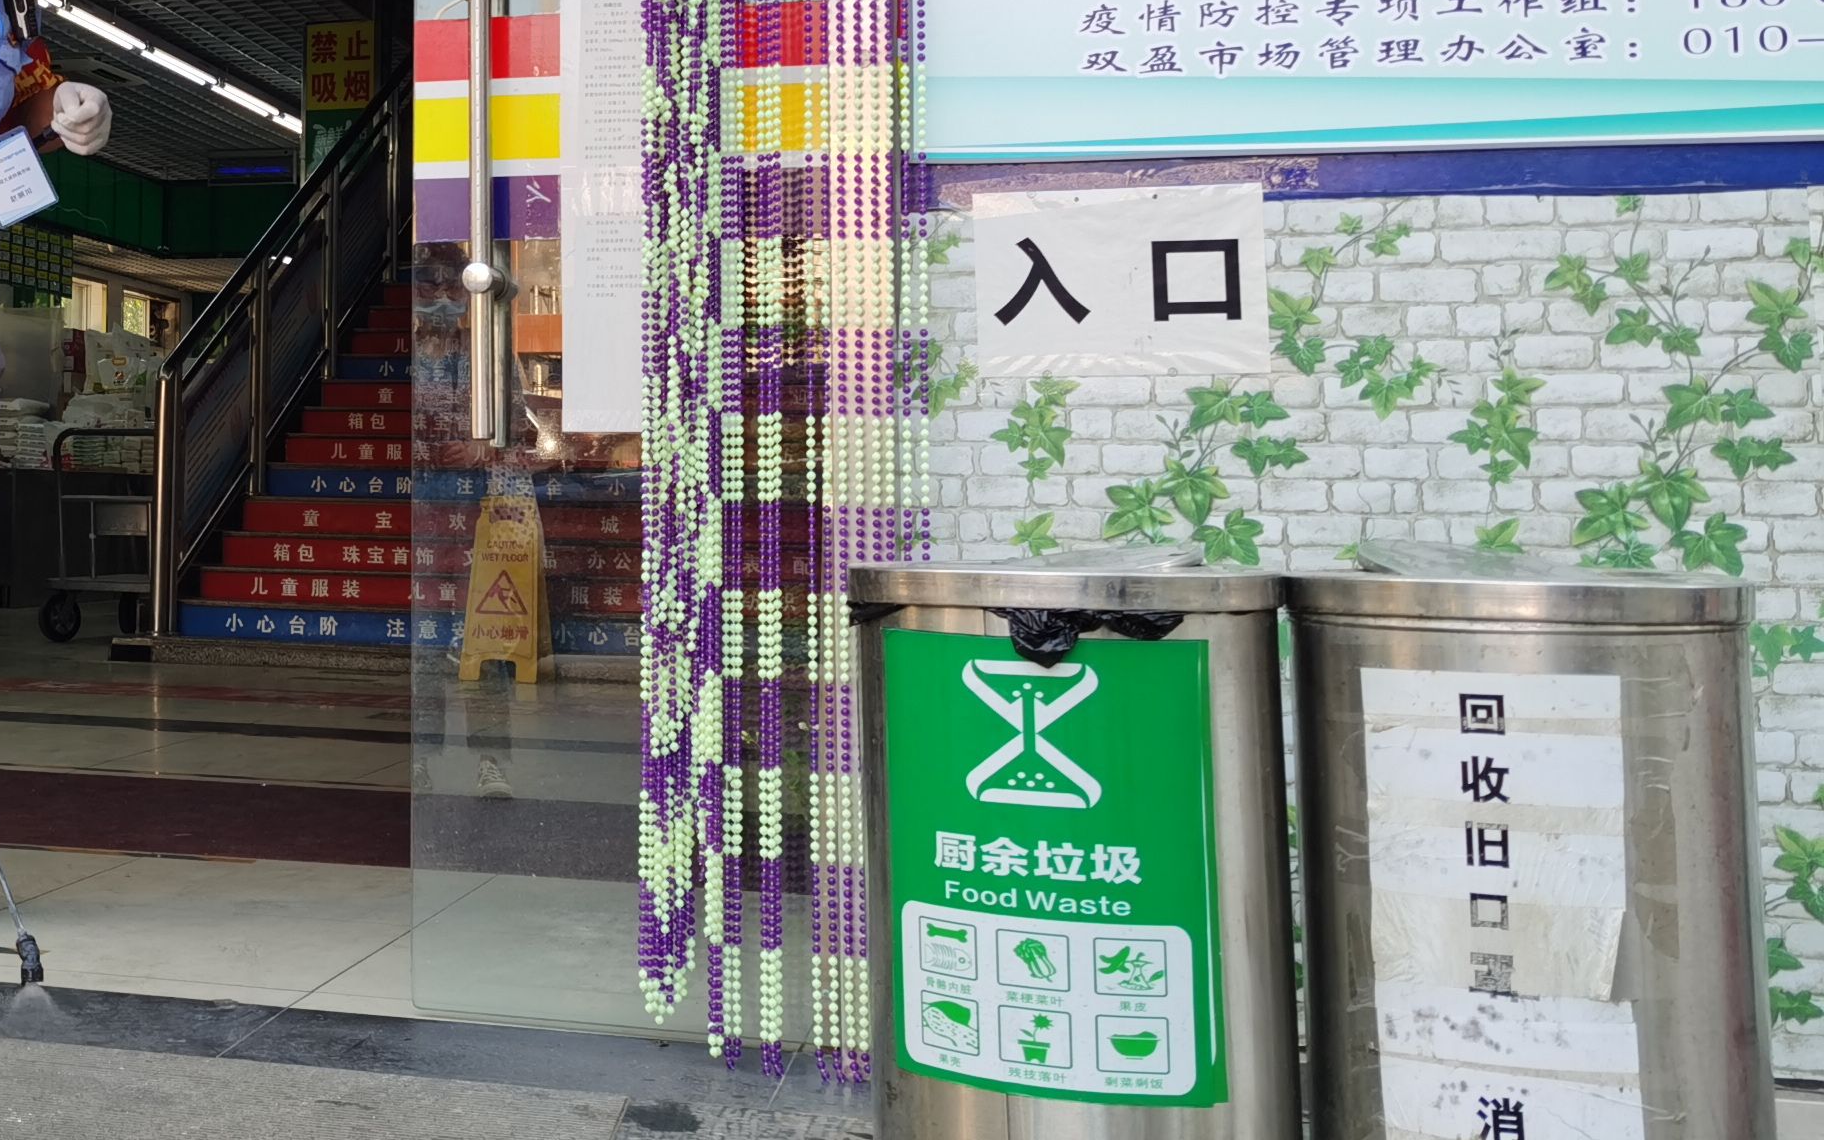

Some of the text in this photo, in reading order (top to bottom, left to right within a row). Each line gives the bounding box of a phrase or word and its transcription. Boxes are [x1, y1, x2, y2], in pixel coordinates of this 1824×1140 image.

[312, 30, 371, 63] 禁止
[1080, 29, 1640, 77] 双盈市场管理办公室：
[312, 69, 370, 103] 吸烟
[993, 236, 1242, 326] 入口
[347, 411, 387, 431] 箱包
[310, 474, 414, 496] 小心台阶
[273, 542, 315, 564] 箱包
[342, 544, 435, 567] 珠宝首饰
[250, 577, 362, 601] 儿童服装
[225, 613, 339, 638] 小心台阶
[472, 624, 529, 641] 小心地滑
[934, 830, 1142, 886] 厨余垃圾
[944, 879, 1133, 917] Food Waste
[1119, 1000, 1148, 1013] 果皮
[937, 1053, 961, 1069] 果壳
[1104, 1075, 1164, 1091] 剩菜剩饭
